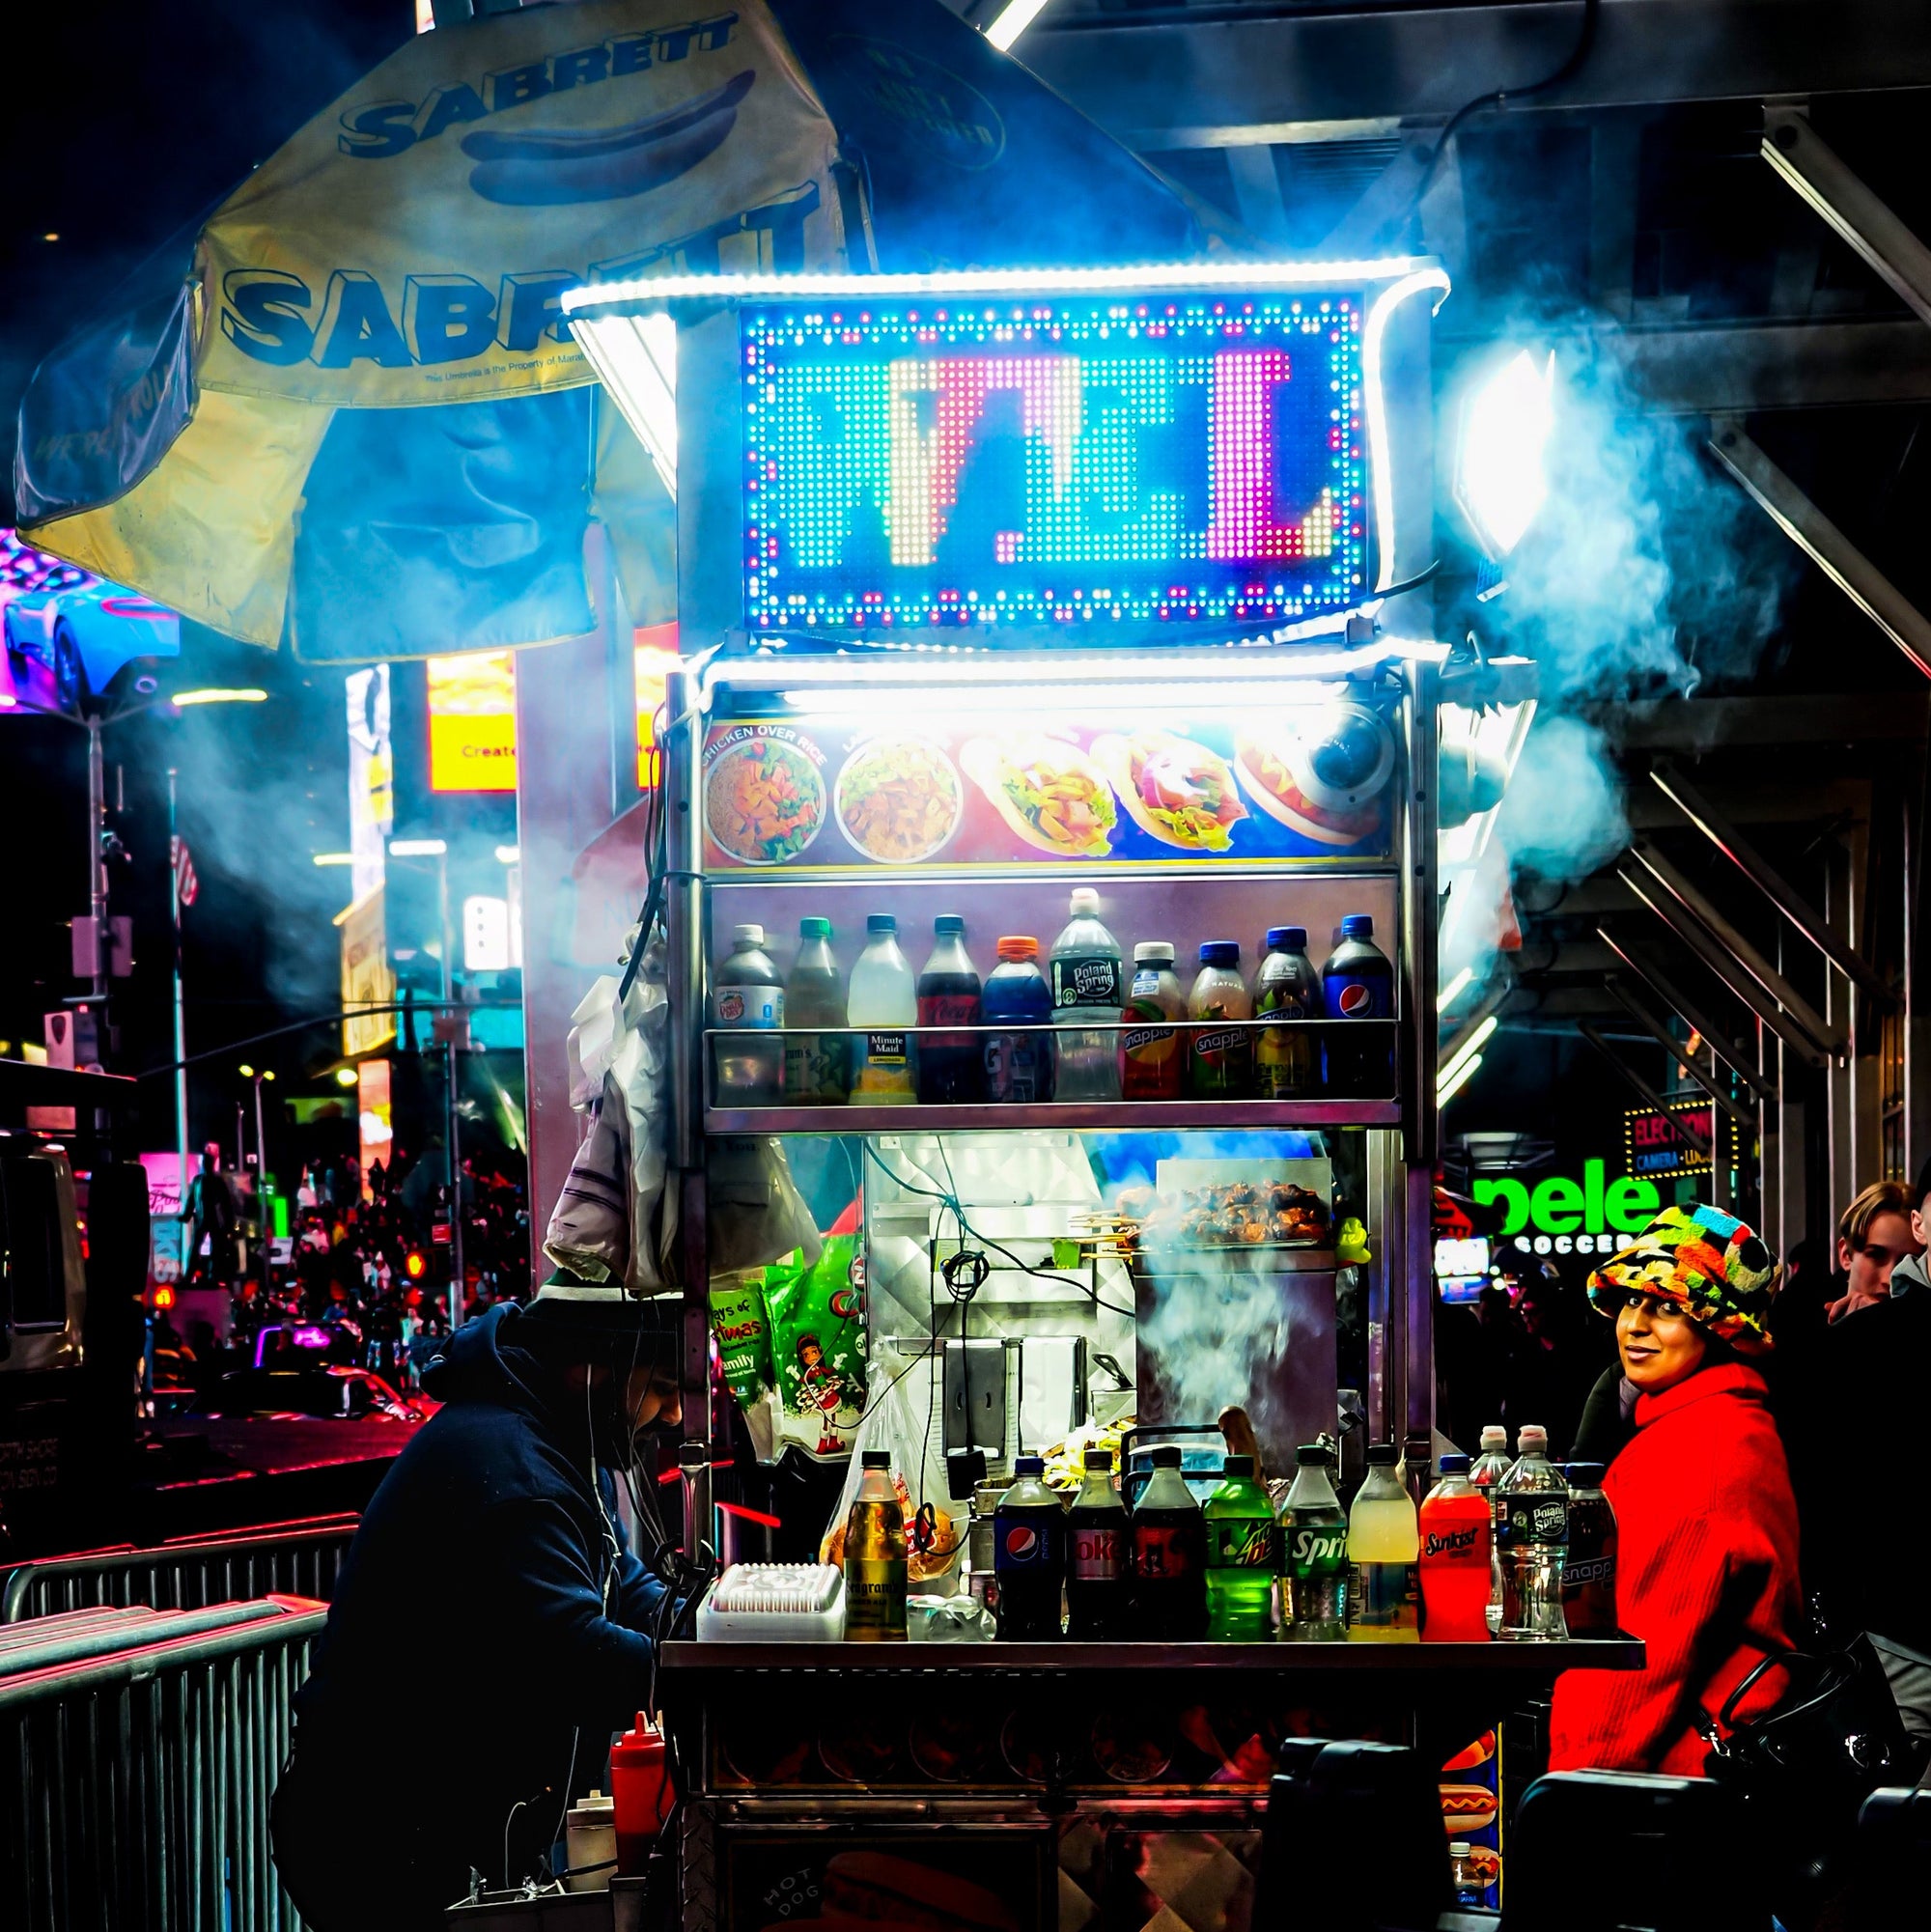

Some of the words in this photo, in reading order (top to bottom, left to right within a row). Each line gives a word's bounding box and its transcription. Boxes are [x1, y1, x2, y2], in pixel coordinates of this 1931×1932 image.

[338, 11, 740, 158] SABRETT
[445, 368, 483, 381] Umbrella
[492, 364, 506, 374] the
[508, 358, 545, 373] Property
[547, 356, 556, 366] of
[702, 725, 754, 770] CHICKEN
[757, 724, 797, 743] OVER
[797, 735, 828, 769] RICE
[1073, 962, 1113, 981] Poland
[1076, 974, 1115, 994] Spring
[871, 1035, 904, 1046] Minute
[876, 1044, 899, 1053] Maid
[1198, 1027, 1248, 1051] snapple
[1637, 1151, 1679, 1172] CAMERA
[714, 1306, 735, 1322] ays
[737, 1300, 751, 1313] of
[722, 1354, 754, 1371] amily
[1533, 1502, 1564, 1519] Poland
[1535, 1515, 1566, 1533] Spring
[1075, 1534, 1121, 1561] oke
[1292, 1530, 1348, 1566] Spri
[1425, 1526, 1479, 1557] Sunkist
[1563, 1560, 1613, 1582] snapp
[763, 1865, 813, 1907] HOT
[777, 1884, 820, 1917] DOG
